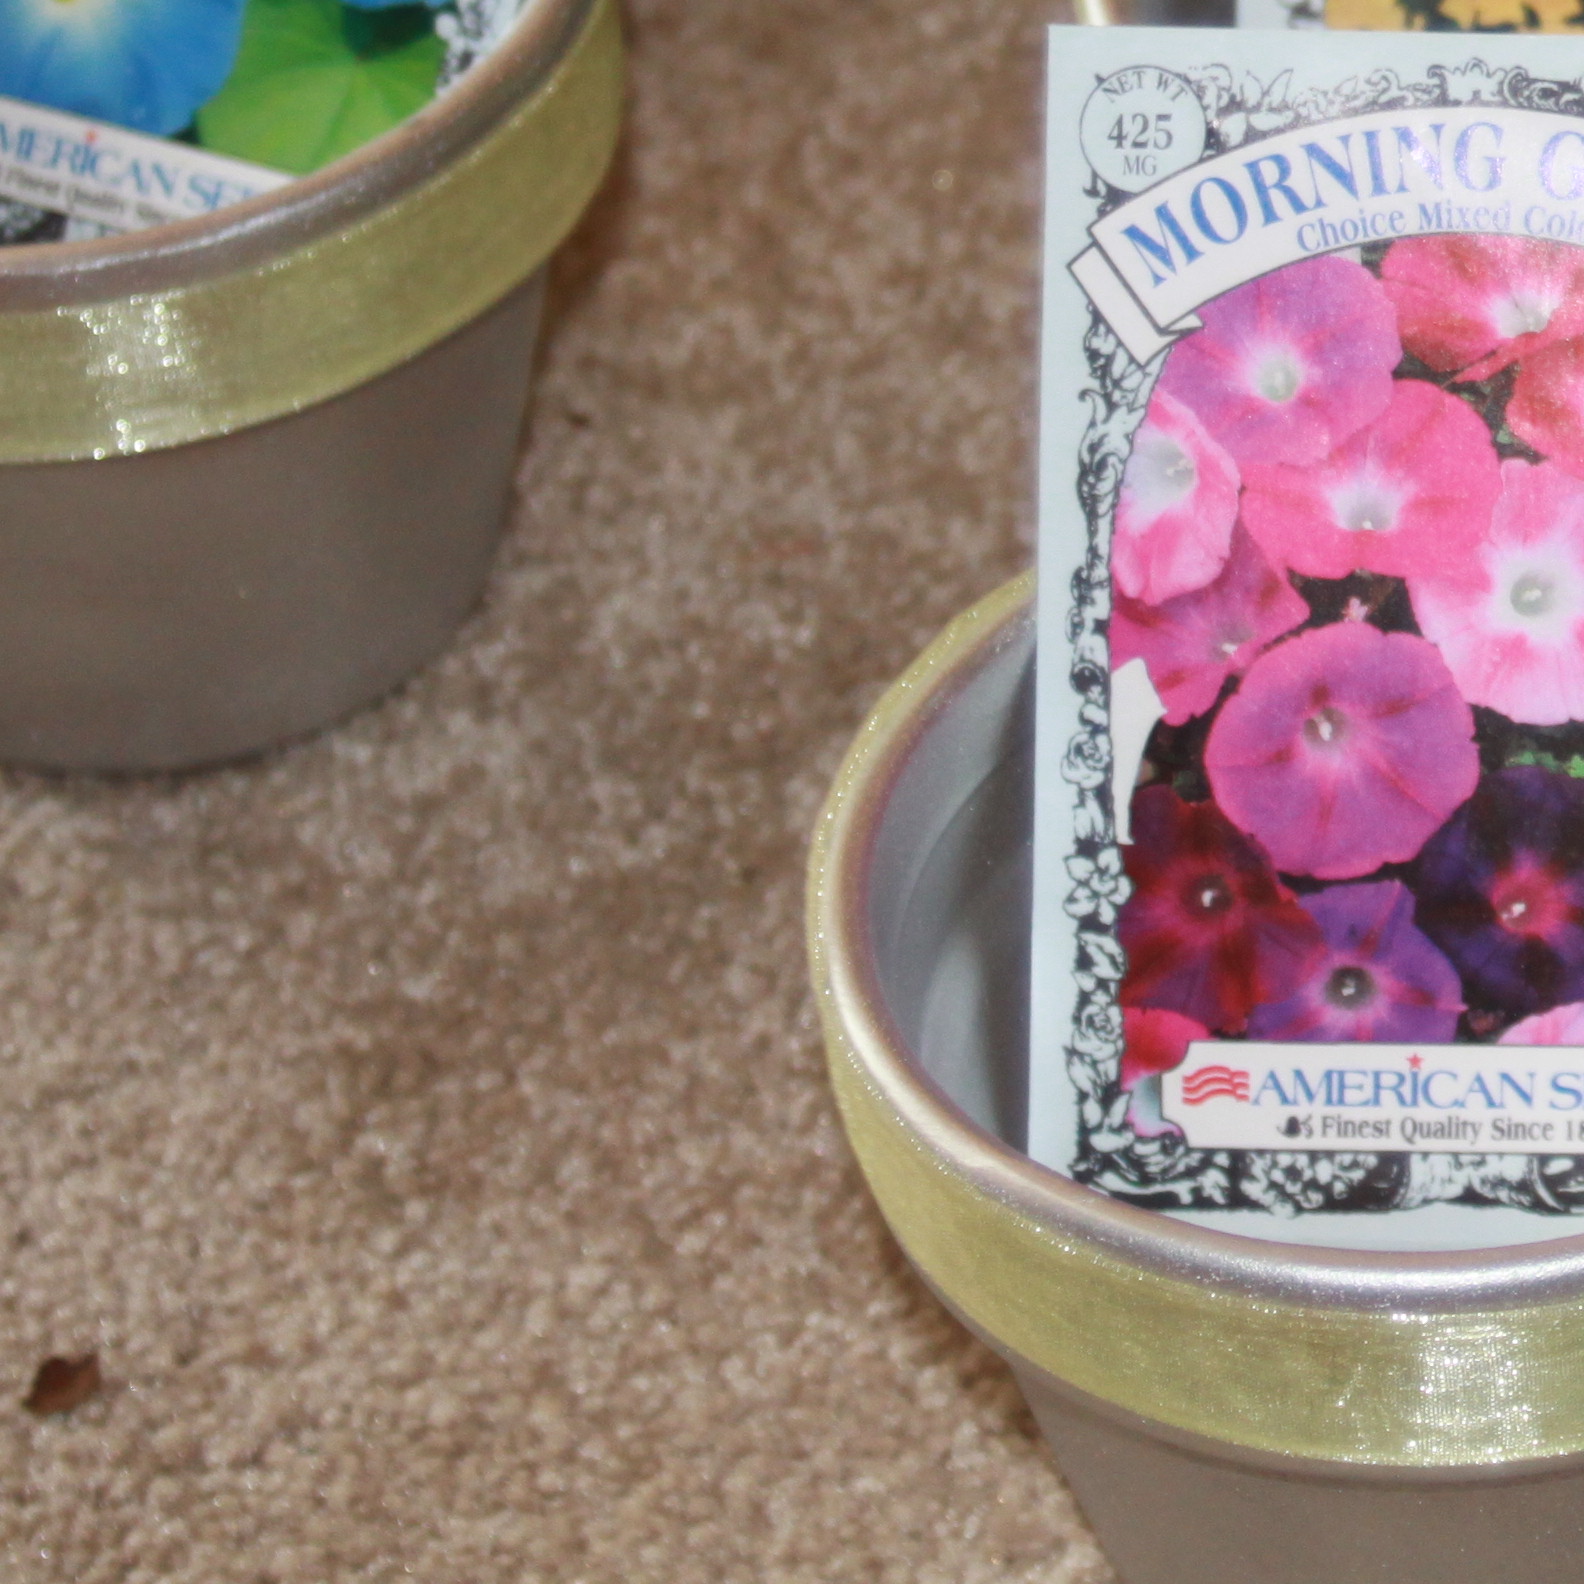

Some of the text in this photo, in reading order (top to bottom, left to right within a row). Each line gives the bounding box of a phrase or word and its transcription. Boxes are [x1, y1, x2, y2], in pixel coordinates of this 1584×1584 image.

[1101, 70, 1188, 104] NET WT
[1107, 112, 1174, 151] 425
[0, 122, 180, 200] MERICAN
[1123, 155, 1158, 177] MG
[1121, 121, 1504, 289] MORNING
[1296, 204, 1408, 253] Choice
[1416, 201, 1511, 234] Mixed
[1251, 1067, 1535, 1109] AMERICAN
[1320, 1116, 1392, 1140] Finest
[1399, 1116, 1482, 1144] Quality
[1490, 1118, 1555, 1142] Since
